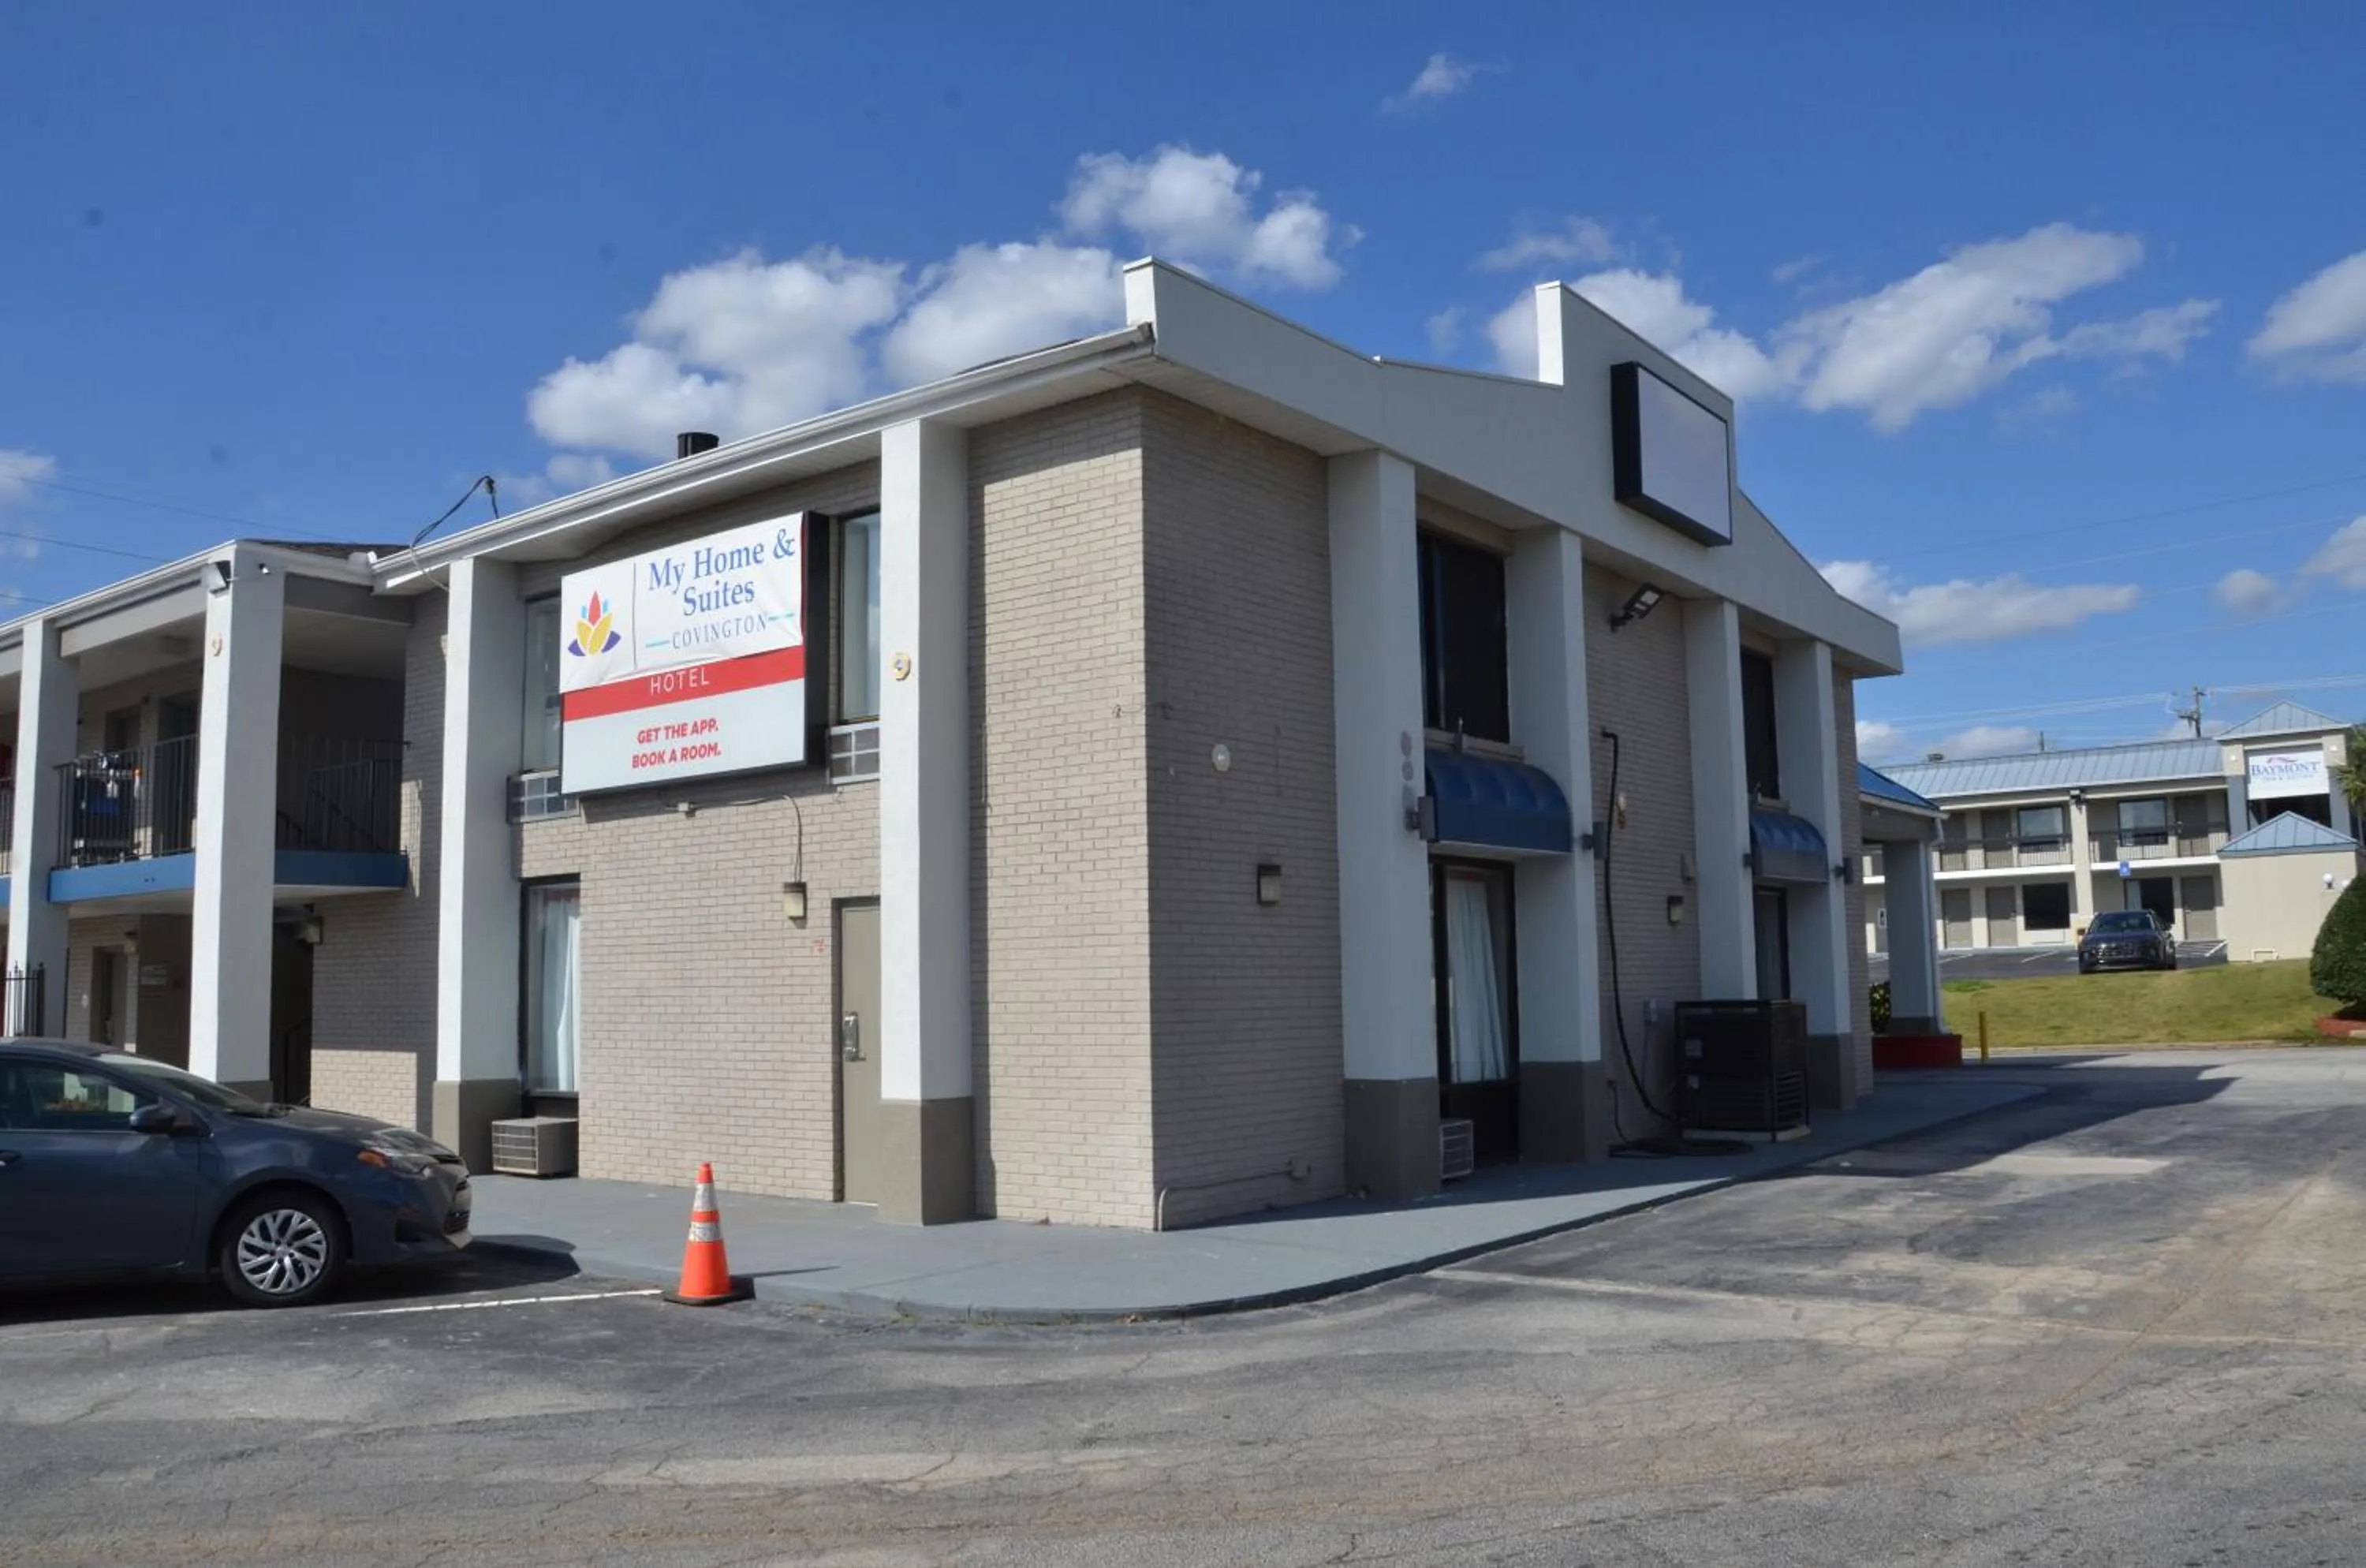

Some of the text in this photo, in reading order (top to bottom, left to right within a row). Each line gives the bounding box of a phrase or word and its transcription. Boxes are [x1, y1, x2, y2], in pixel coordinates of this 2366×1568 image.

[648, 528, 796, 595] My Home &
[683, 581, 755, 616] Suites
[672, 613, 768, 650] COVINGTON
[650, 666, 709, 695] HOTEL
[637, 718, 719, 745] GET THE APP.
[632, 742, 722, 768] BOOK A ROOM.
[2252, 761, 2321, 777] BAYMONT
